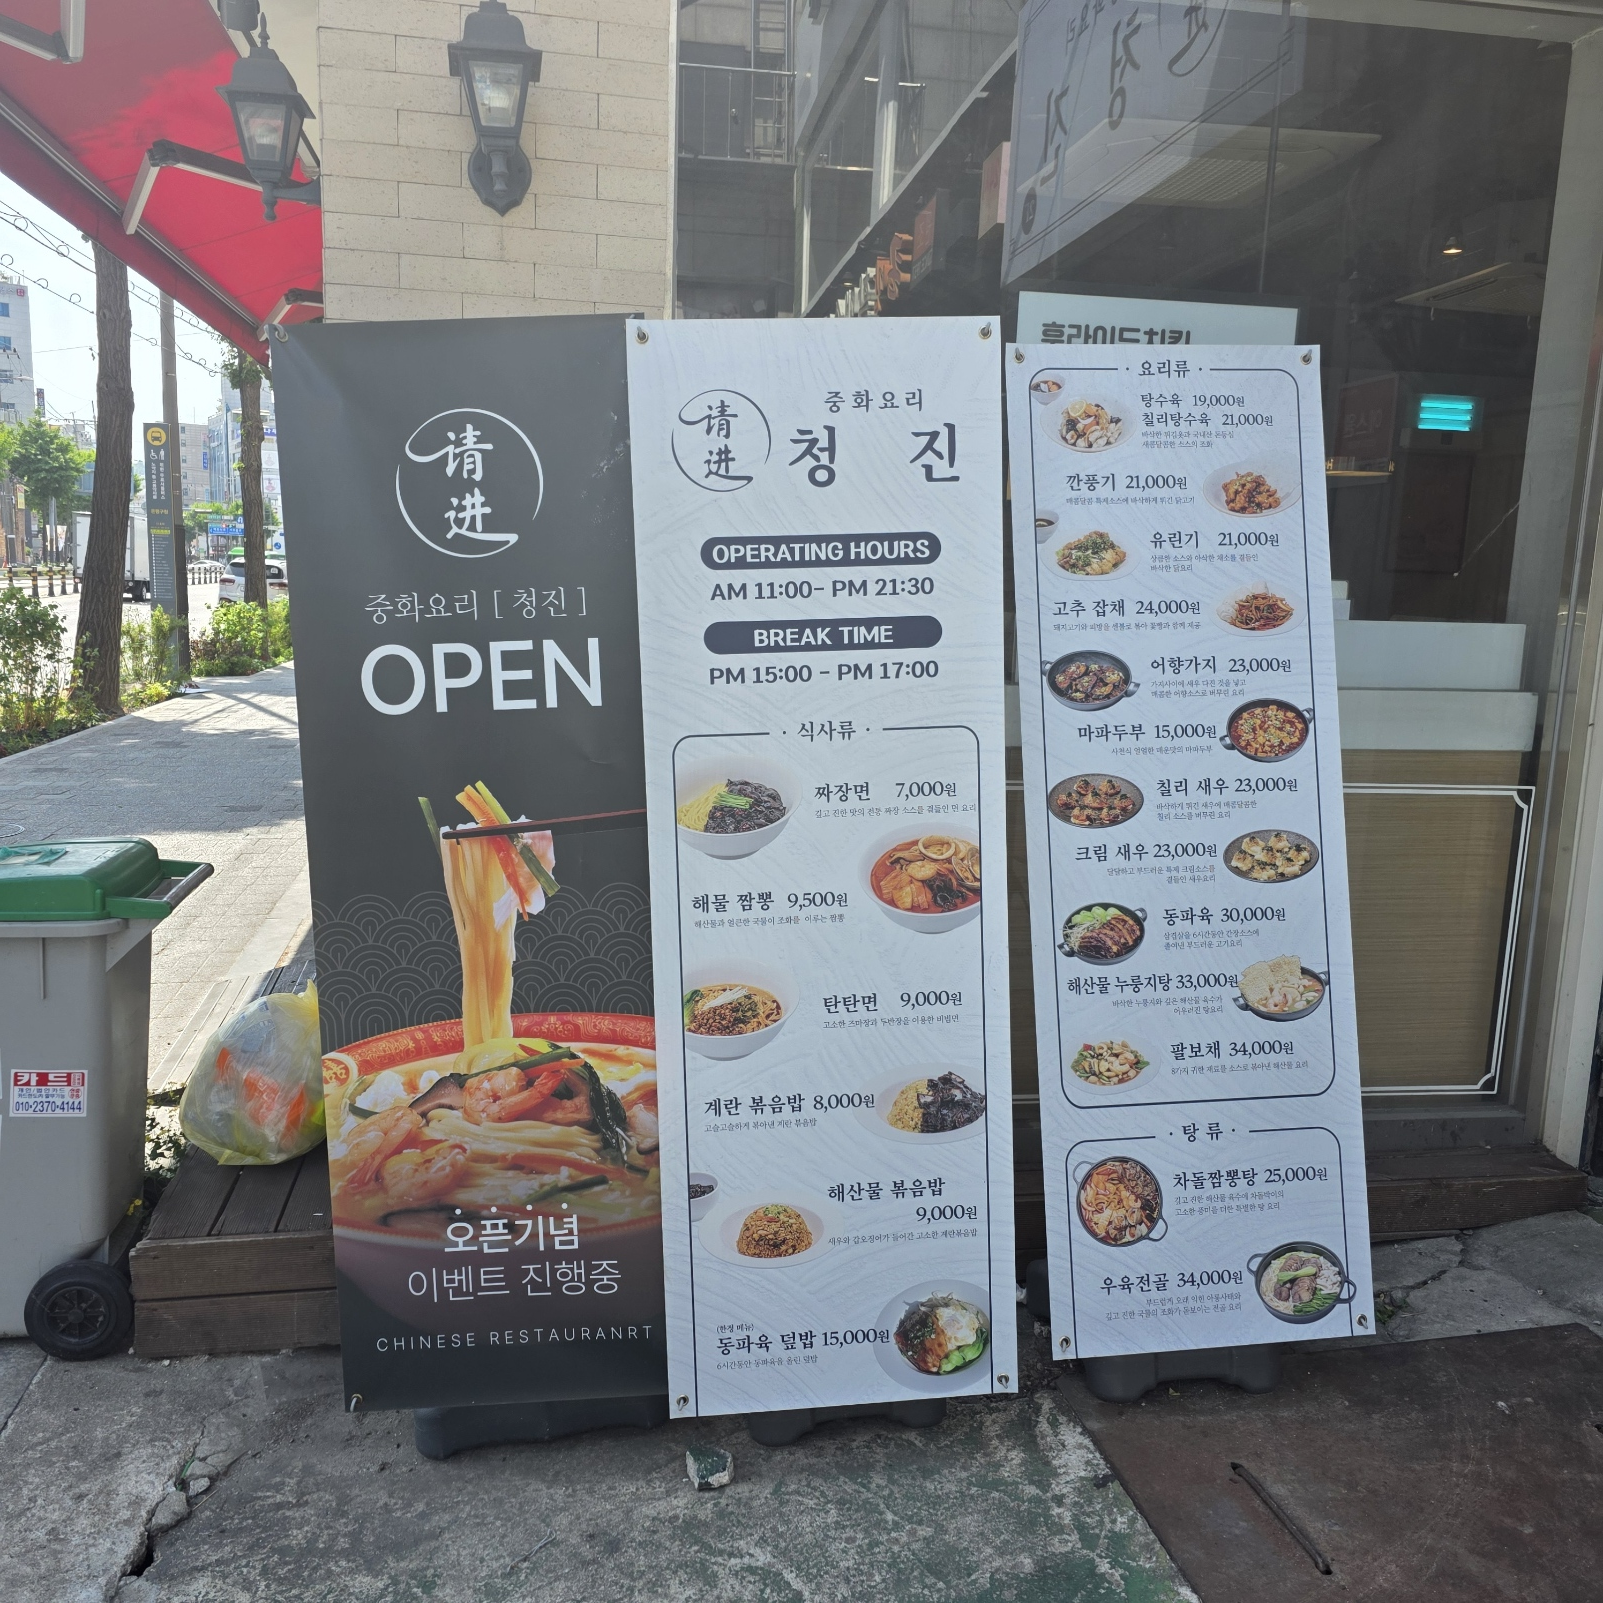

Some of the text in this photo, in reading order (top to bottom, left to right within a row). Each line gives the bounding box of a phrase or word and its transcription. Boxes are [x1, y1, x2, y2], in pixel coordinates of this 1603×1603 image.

[1138, 359, 1190, 379] 요리류
[824, 388, 923, 413] 중화요리
[1140, 393, 1245, 409] 탕수육 19,000원
[1142, 412, 1273, 428] 칠리탕수육 21,000원
[1066, 473, 1188, 492] 깐풍기 21,000원
[1150, 530, 1280, 549] 유린기 21,000원
[712, 539, 930, 564] OPERATING HOURS
[1150, 564, 1193, 572] 바삭한 닭요리
[710, 582, 747, 601] AM
[831, 579, 868, 598] PM
[874, 576, 935, 596] 21:30
[364, 590, 478, 625] 중화요리
[1052, 599, 1201, 618] 고추 잡채 24,000원
[753, 625, 894, 647] BREAK TIME
[709, 667, 746, 685] PM
[752, 664, 813, 684] 15:00
[837, 663, 873, 681] PM
[879, 660, 939, 680] 17:00
[1150, 656, 1292, 676] 어향가지 23,000원
[361, 637, 603, 716] OPEN
[1150, 680, 1184, 688] 가지사이에
[1186, 679, 1200, 688] 새우
[1202, 679, 1216, 687] 다진
[1218, 679, 1231, 687] 것을
[1150, 689, 1245, 698] 매콤한 어향소스로 버무린 요리
[797, 720, 857, 742] 식사류
[1077, 723, 1217, 743] 마파두부 15,000원
[814, 780, 957, 803] 짜장면 7,000원
[1156, 777, 1298, 797] 칠리 새우 23,000원
[815, 803, 976, 819] 깊고 진한 맛의 전통 짜장 소스를 곁들인 면 요리
[1075, 842, 1217, 862] 크림 새우 23,000원
[1107, 865, 1215, 877] 달달하고 부드러운 특제 크림소스를
[1166, 874, 1216, 884] 곁들인 새우요리
[692, 891, 848, 914] 해물 짬뽕 9,500원
[694, 913, 846, 929] 해산물과 얼큰한 국물이 조화를 이루는 짬뽕
[1162, 906, 1286, 927] 동파육 30,000원
[1067, 972, 1238, 996] 해산물 누룽지탕 33,000원
[822, 990, 963, 1014] 탄탄면 9,000원
[823, 1014, 959, 1029] 고소한 즈마장과 두반장을 이용한 비빔면
[1170, 1039, 1294, 1061] 팔보채 34,000원
[1171, 1060, 1309, 1075] 8가지 귀한 재료를 소스로 볶아낸 해산물 요리
[16, 1073, 68, 1086] 카드
[704, 1092, 875, 1118] 계란 볶음밥 8,000원
[704, 1118, 817, 1132] 고슬고슬하게 볶아낸 계란 볶음밥
[1173, 1166, 1328, 1191] 차돌짬뽕탕 25,000원
[827, 1177, 945, 1202] 해산물 볶음밥
[916, 1204, 978, 1224] 9,000원
[444, 1214, 579, 1254] 오픈기념
[828, 1228, 978, 1246] 새우와 갑오징어가 들어간 고소한 계란볶음밥
[408, 1259, 621, 1302] 이벤트 진행중
[1100, 1269, 1243, 1296] 우육전골 34,000원
[376, 1325, 652, 1352] CHINESE RESTAURANRT
[716, 1323, 754, 1334] (한정 메뉴)
[716, 1328, 890, 1356] 동파육 덮밥 15,000원
[716, 1355, 818, 1370] 6시간동안 동파육을 올린 덮밥
